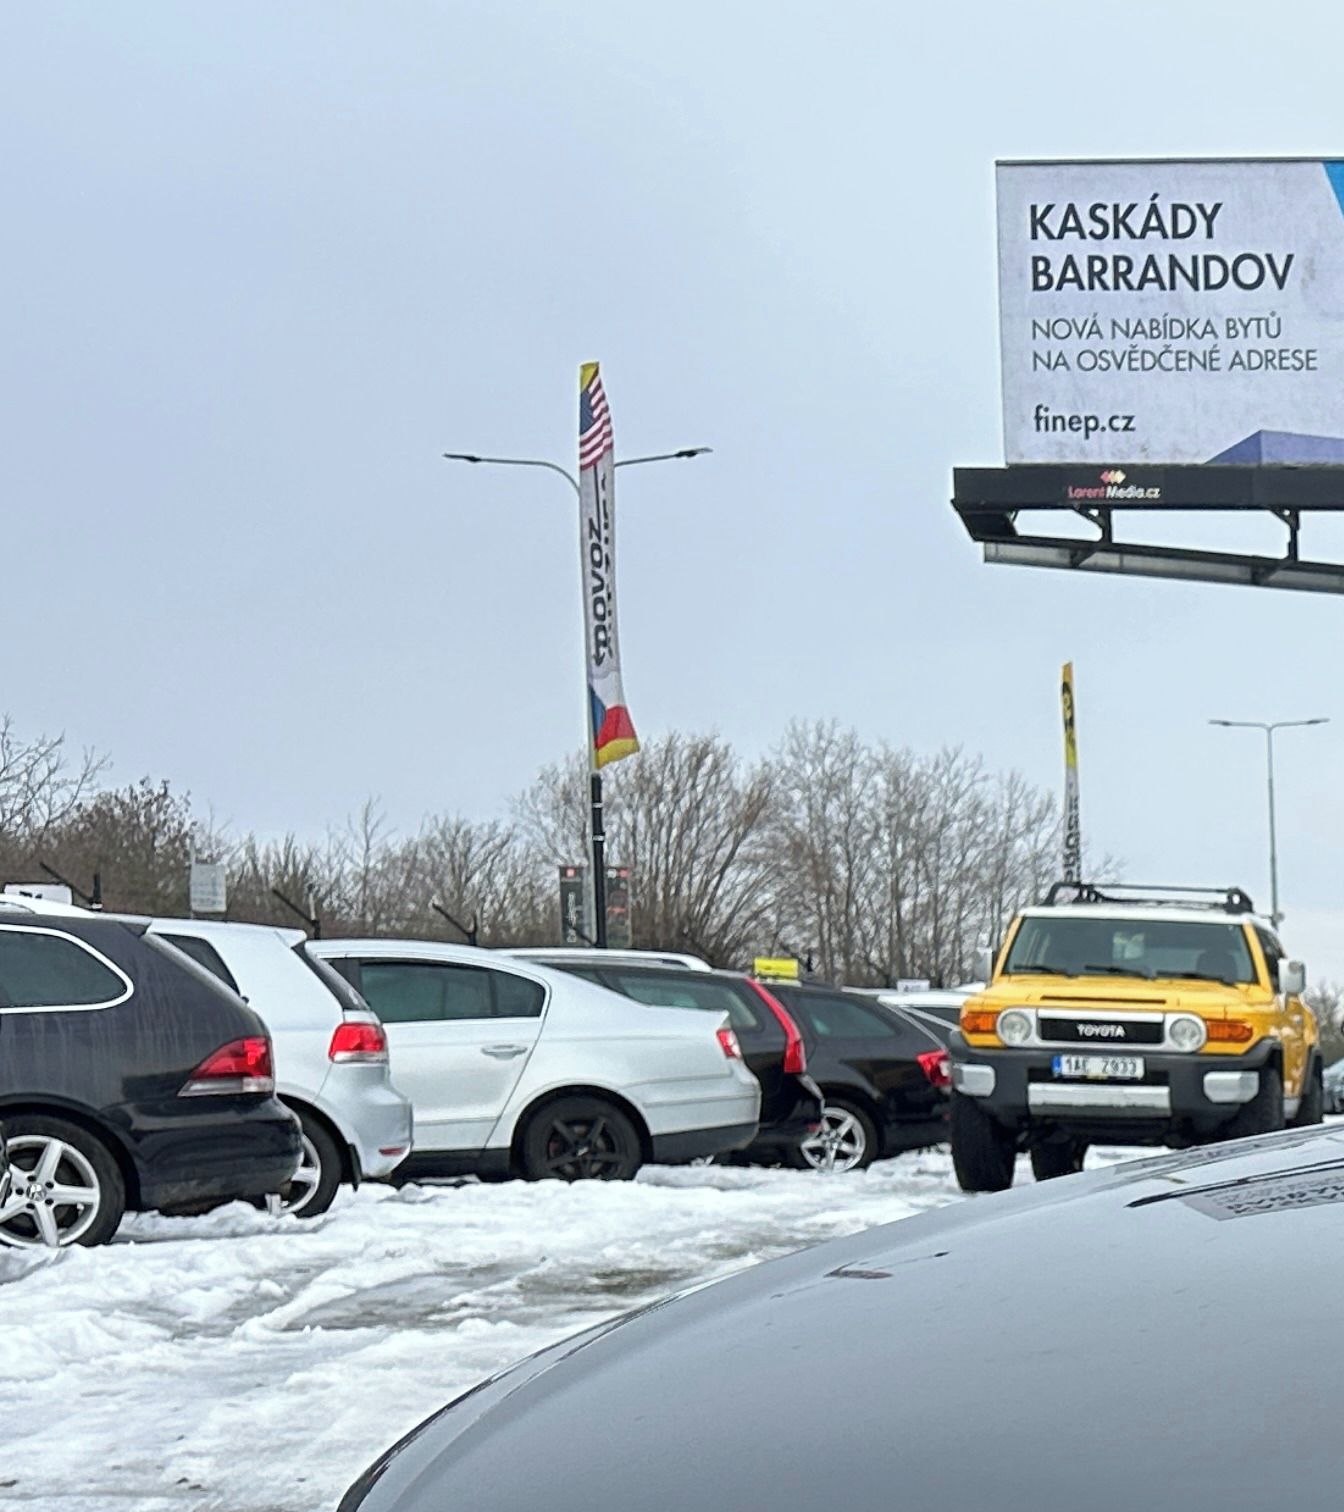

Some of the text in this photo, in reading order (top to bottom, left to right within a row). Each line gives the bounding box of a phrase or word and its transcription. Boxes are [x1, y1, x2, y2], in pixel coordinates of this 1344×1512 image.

[1029, 193, 1223, 240] KASKÁDY
[1031, 252, 1295, 292] BARRANDOV
[1032, 311, 1282, 340] NOVÁ NABÍDKA BYTŮ
[1032, 344, 1318, 372] NA OSVĚDČENÉ ADRESE
[1034, 404, 1136, 440] finep.cz
[1077, 1023, 1126, 1038] TOYOTA
